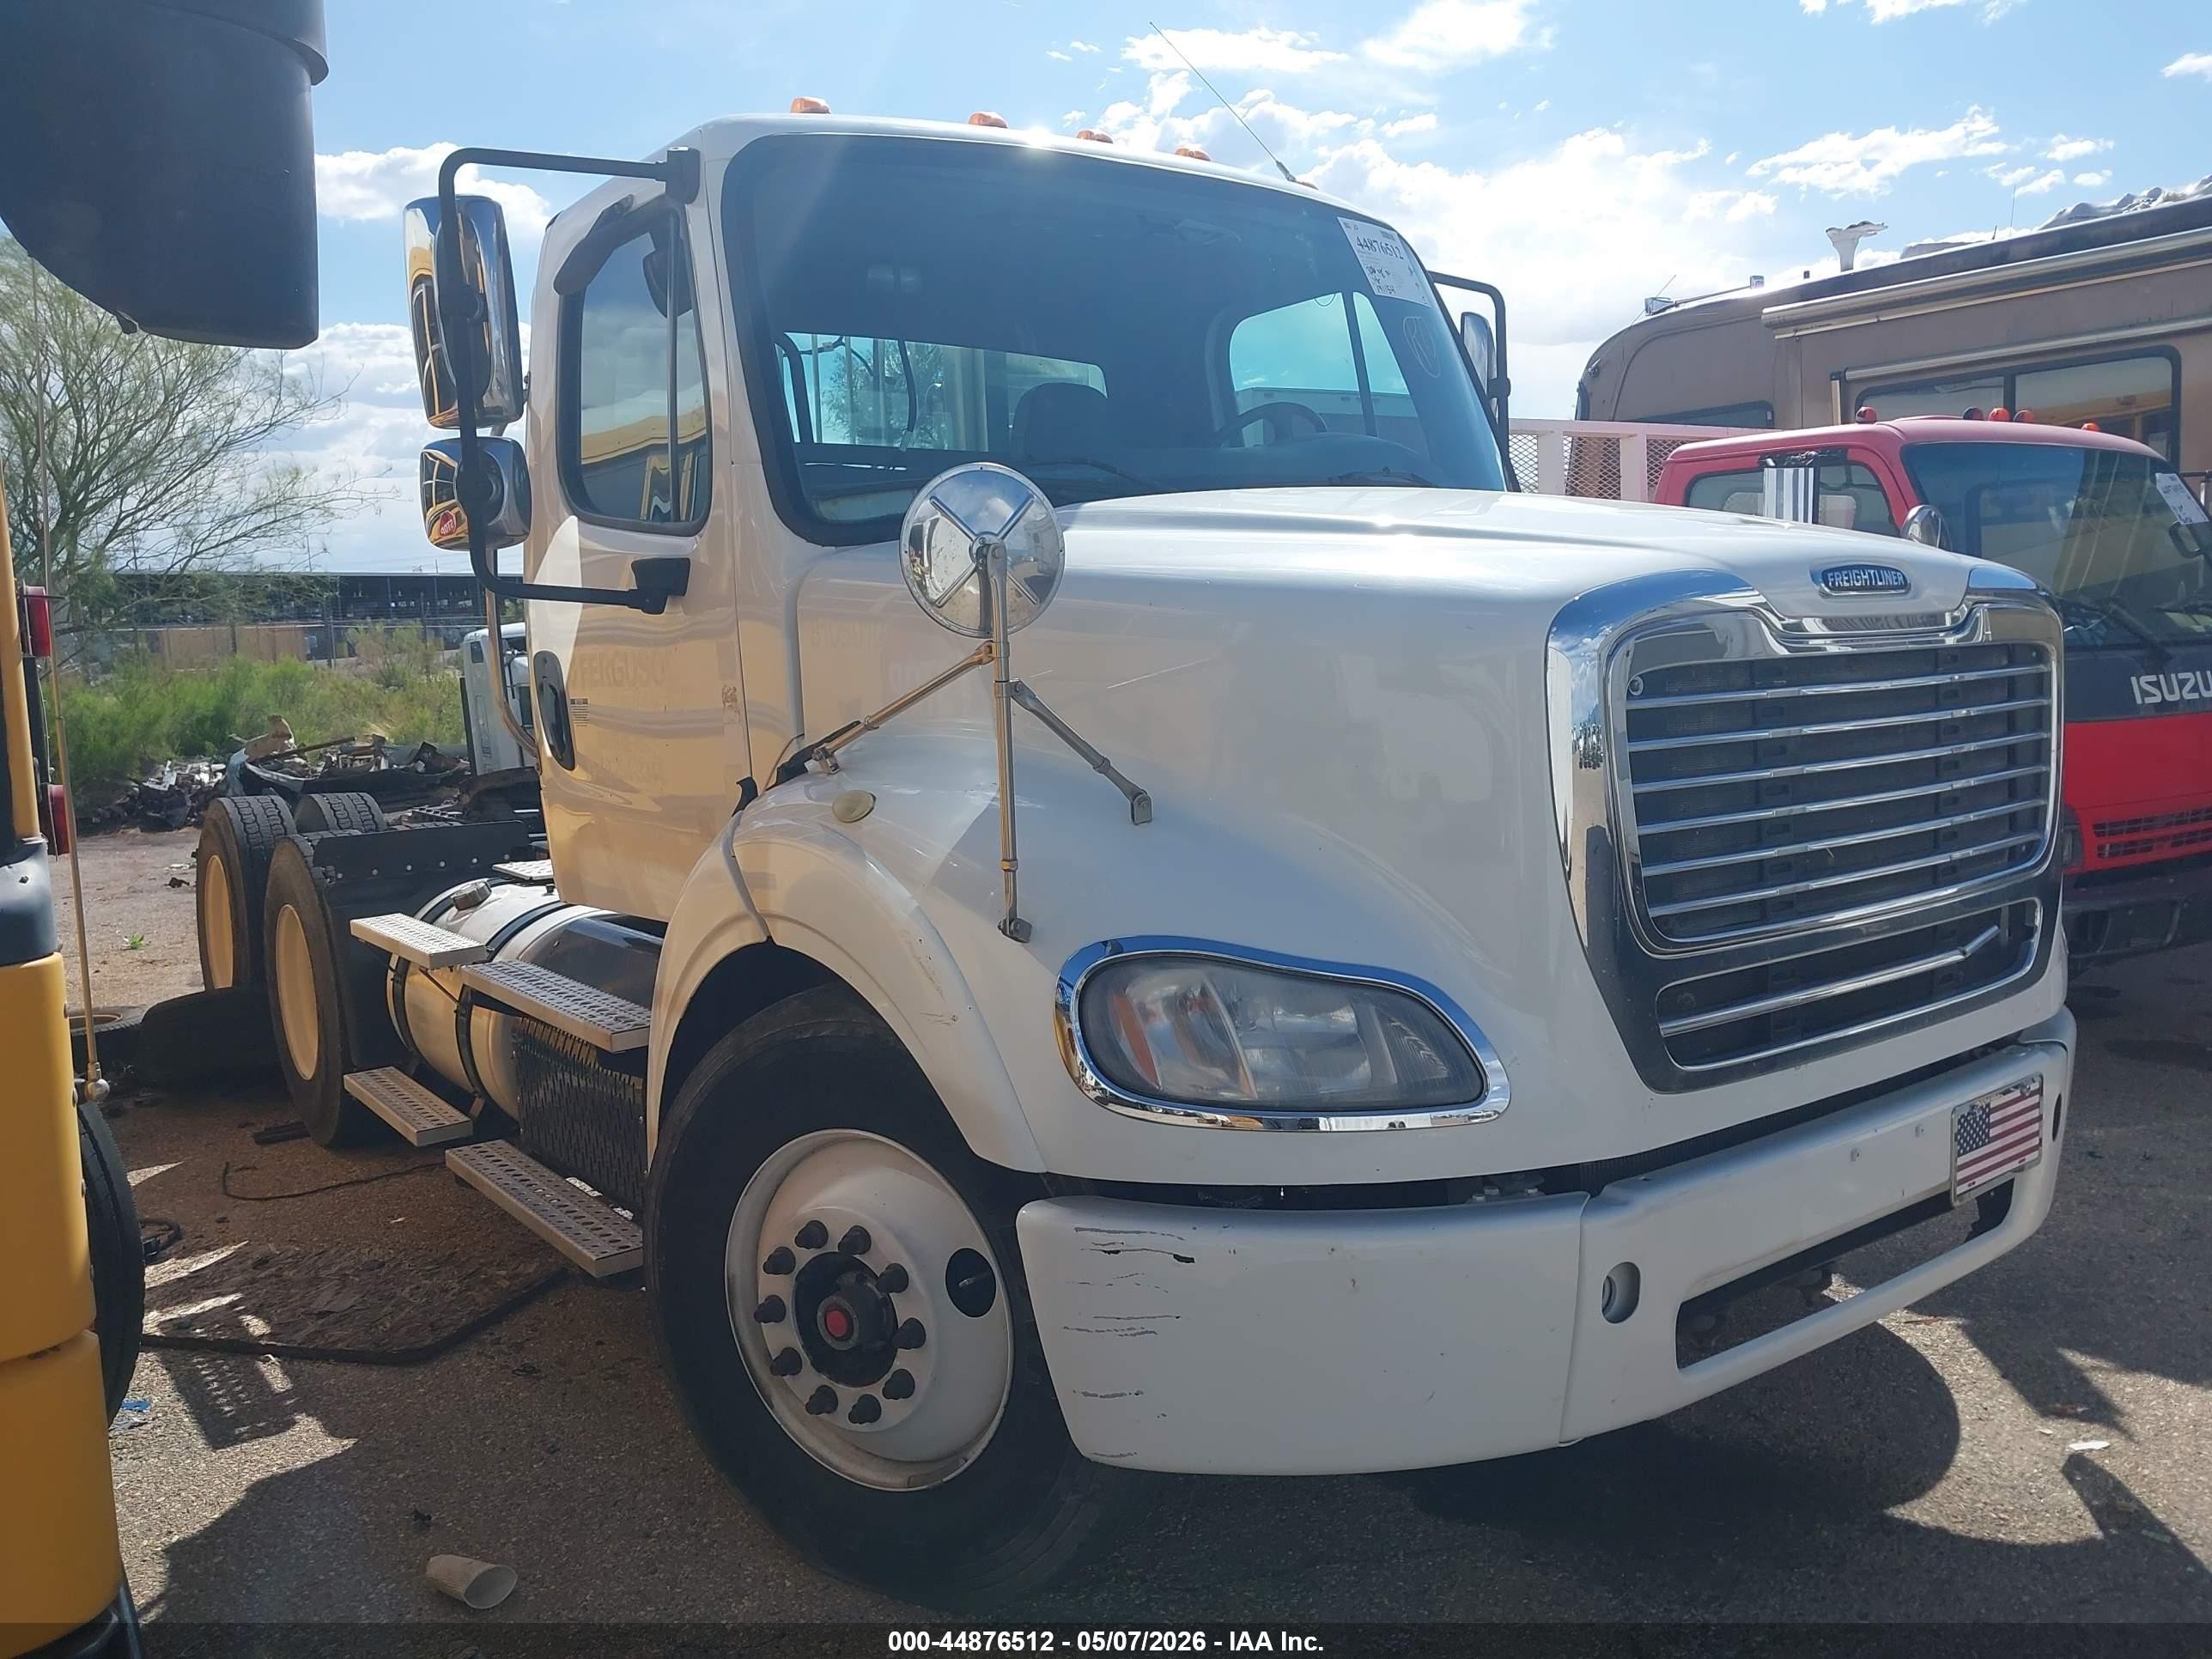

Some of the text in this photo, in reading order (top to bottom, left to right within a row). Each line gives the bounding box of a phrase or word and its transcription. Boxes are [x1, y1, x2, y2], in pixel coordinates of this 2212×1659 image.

[1356, 235, 1404, 260] 44876512
[1826, 568, 1905, 587] FREIGHTLINER
[2130, 670, 2212, 704] ISUZU
